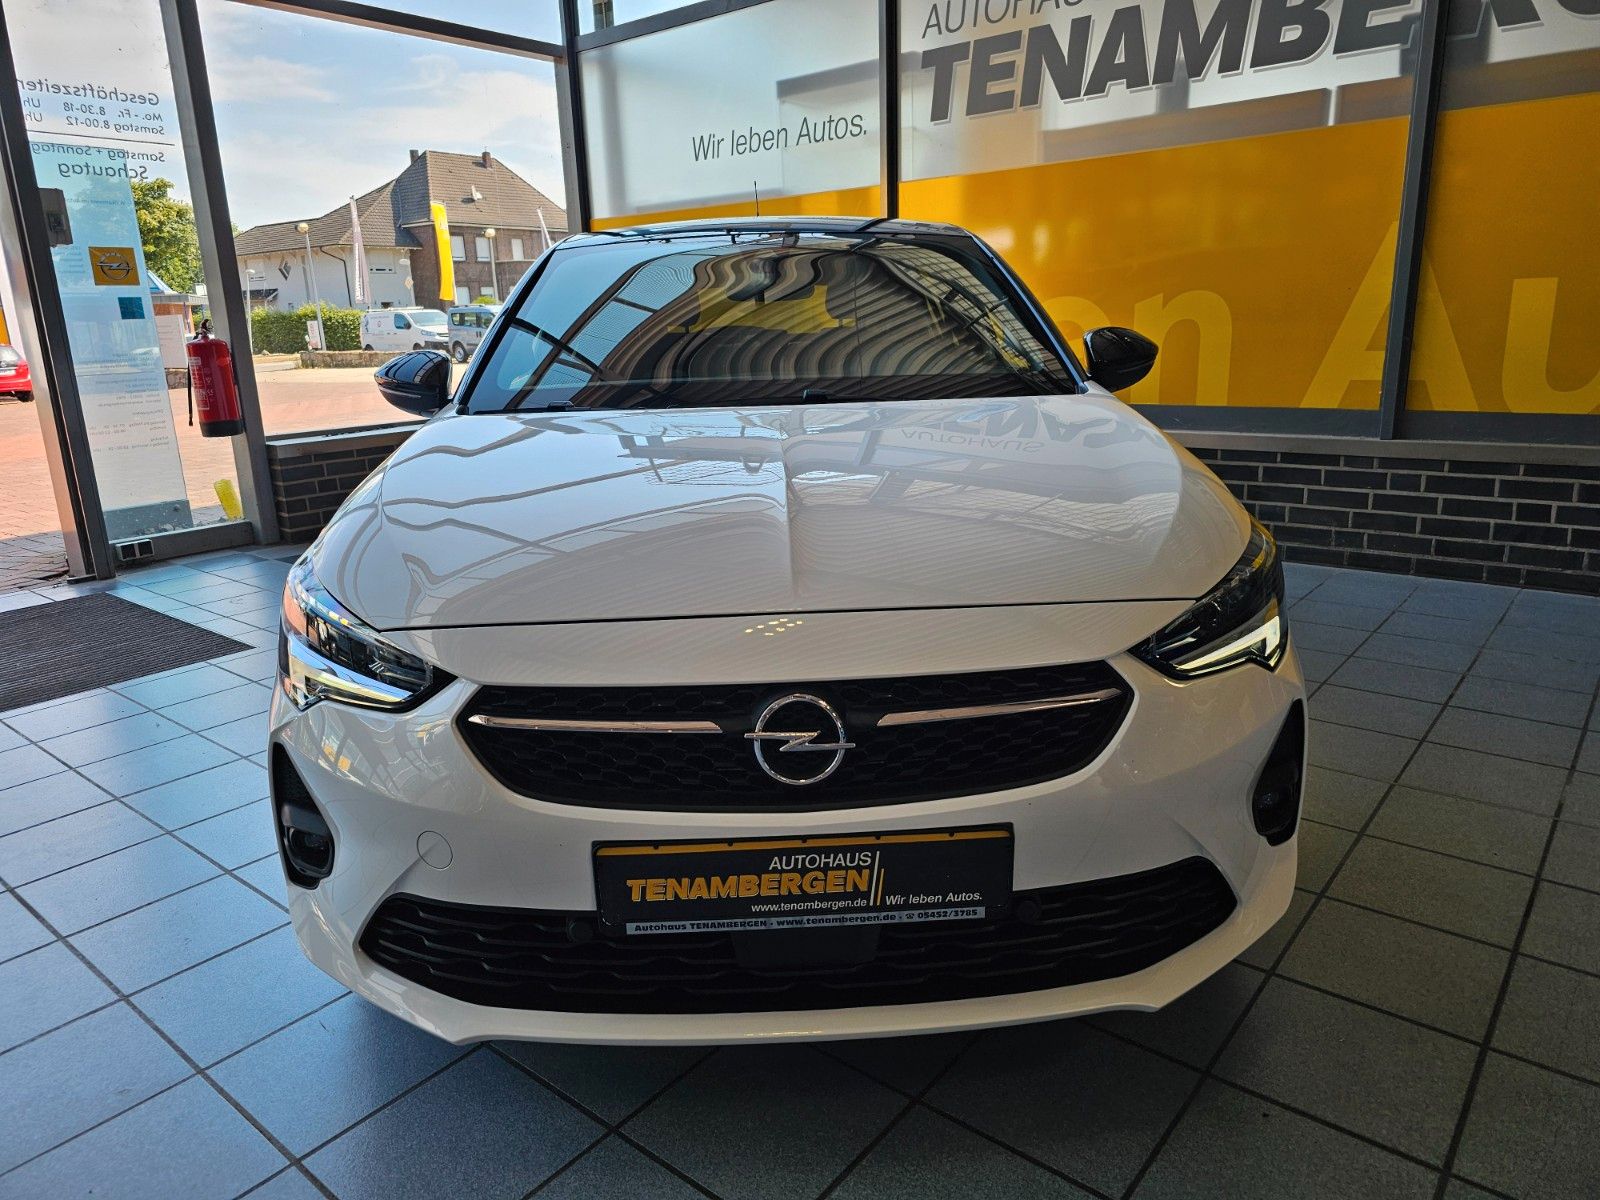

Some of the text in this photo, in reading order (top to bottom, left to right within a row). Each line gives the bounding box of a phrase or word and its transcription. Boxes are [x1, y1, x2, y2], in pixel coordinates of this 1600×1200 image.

[692, 114, 867, 161] Wir leben Autos.
[768, 851, 872, 871] AUTOHAUS
[626, 868, 871, 902] TENAMBERGEN
[751, 898, 867, 912] www.tenambergen.de
[885, 891, 983, 906] Wir leben Autos.
[634, 908, 978, 932] Autohaus TENAMBERGEN www.tenambergen.de 05452/3785
